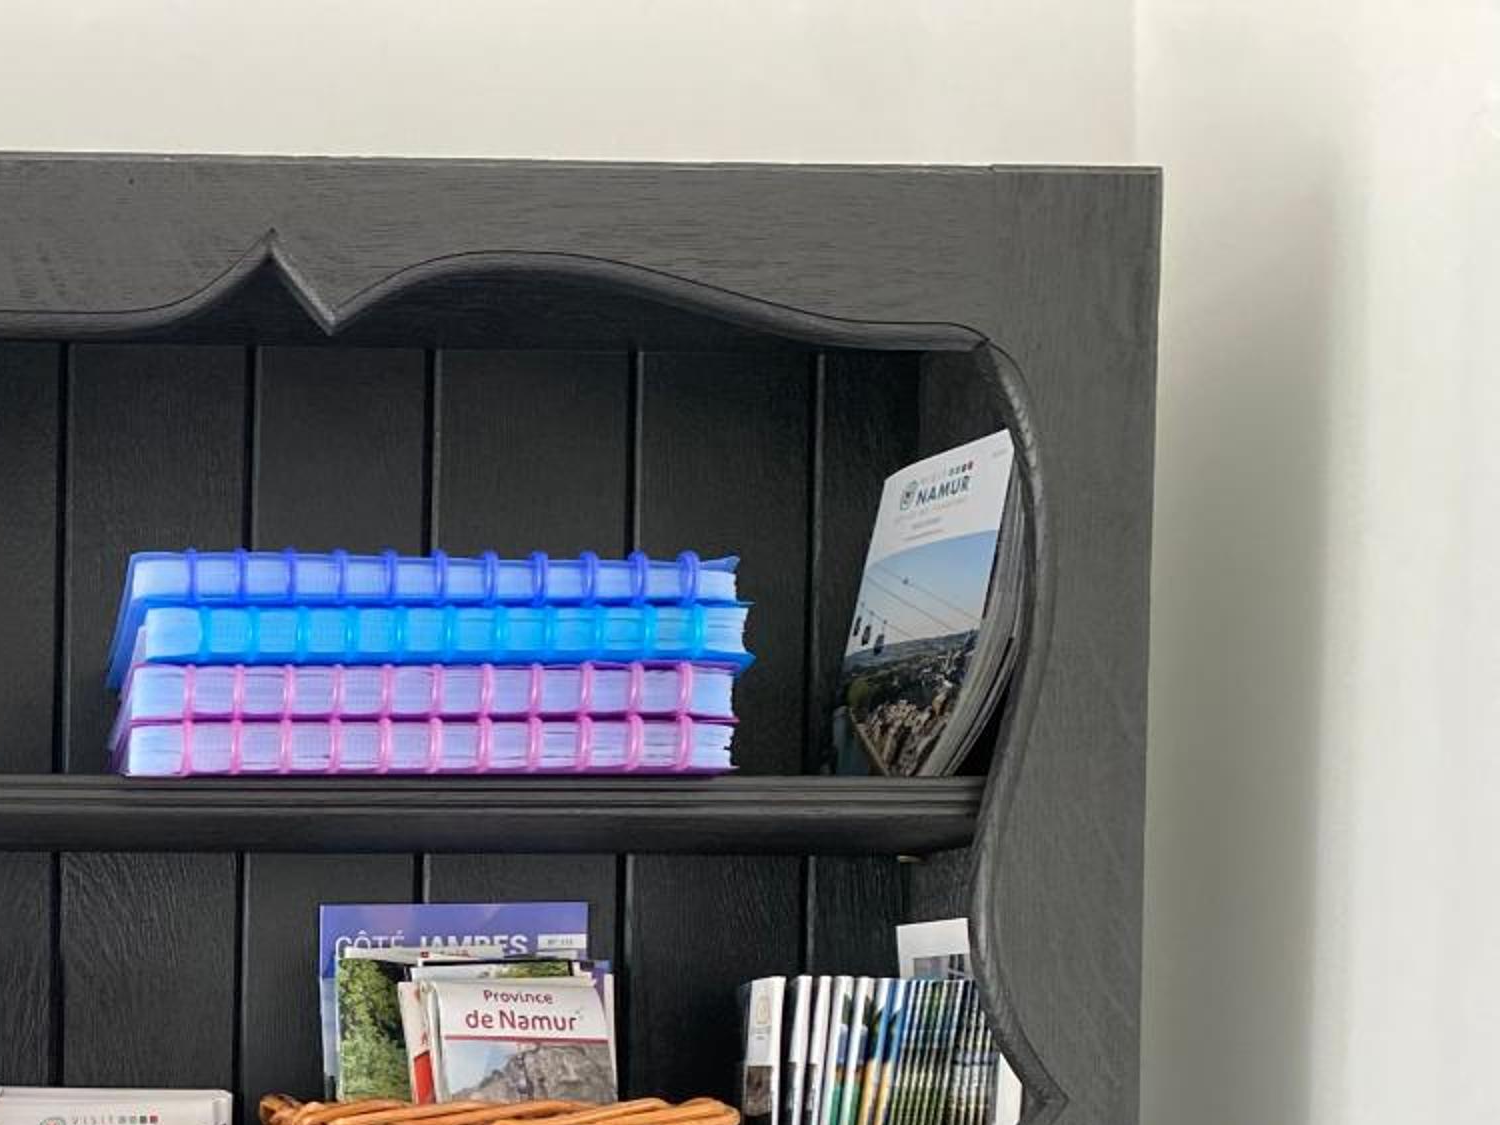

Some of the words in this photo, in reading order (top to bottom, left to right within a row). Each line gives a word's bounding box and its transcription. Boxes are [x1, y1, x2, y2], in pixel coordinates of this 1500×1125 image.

[915, 475, 971, 506] NAMUR
[483, 989, 554, 1005] Province
[465, 1009, 494, 1029] de
[498, 1009, 577, 1031] Namur
